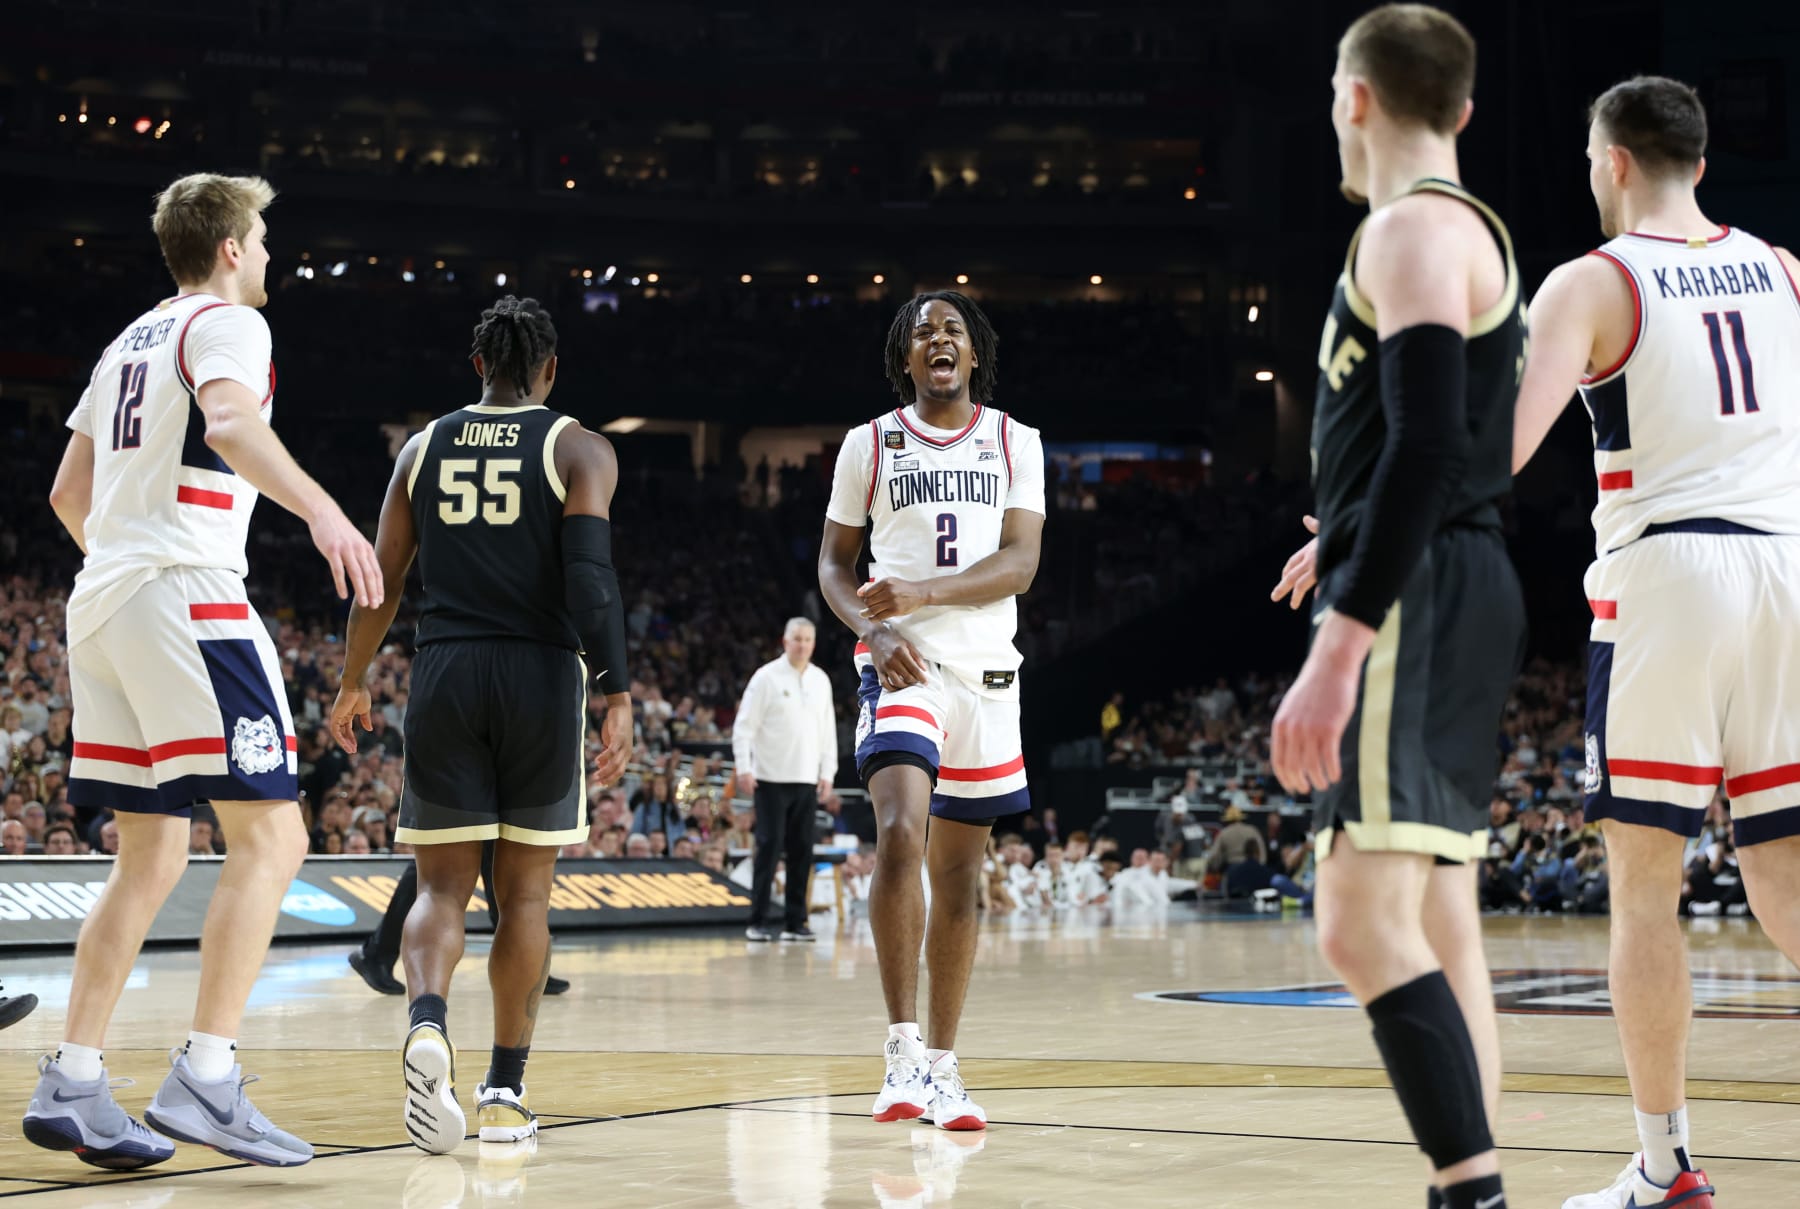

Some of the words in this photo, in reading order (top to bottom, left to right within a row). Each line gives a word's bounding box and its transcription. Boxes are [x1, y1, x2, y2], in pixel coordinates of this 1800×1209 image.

[1653, 262, 1773, 298] KARABAN
[120, 318, 176, 352] SPENCER
[1702, 311, 1760, 415] 11
[113, 360, 148, 451] 12
[454, 422, 520, 447] JONES
[438, 459, 522, 525] 55
[889, 470, 999, 511] CONNECTICUT
[936, 513, 957, 567] 2
